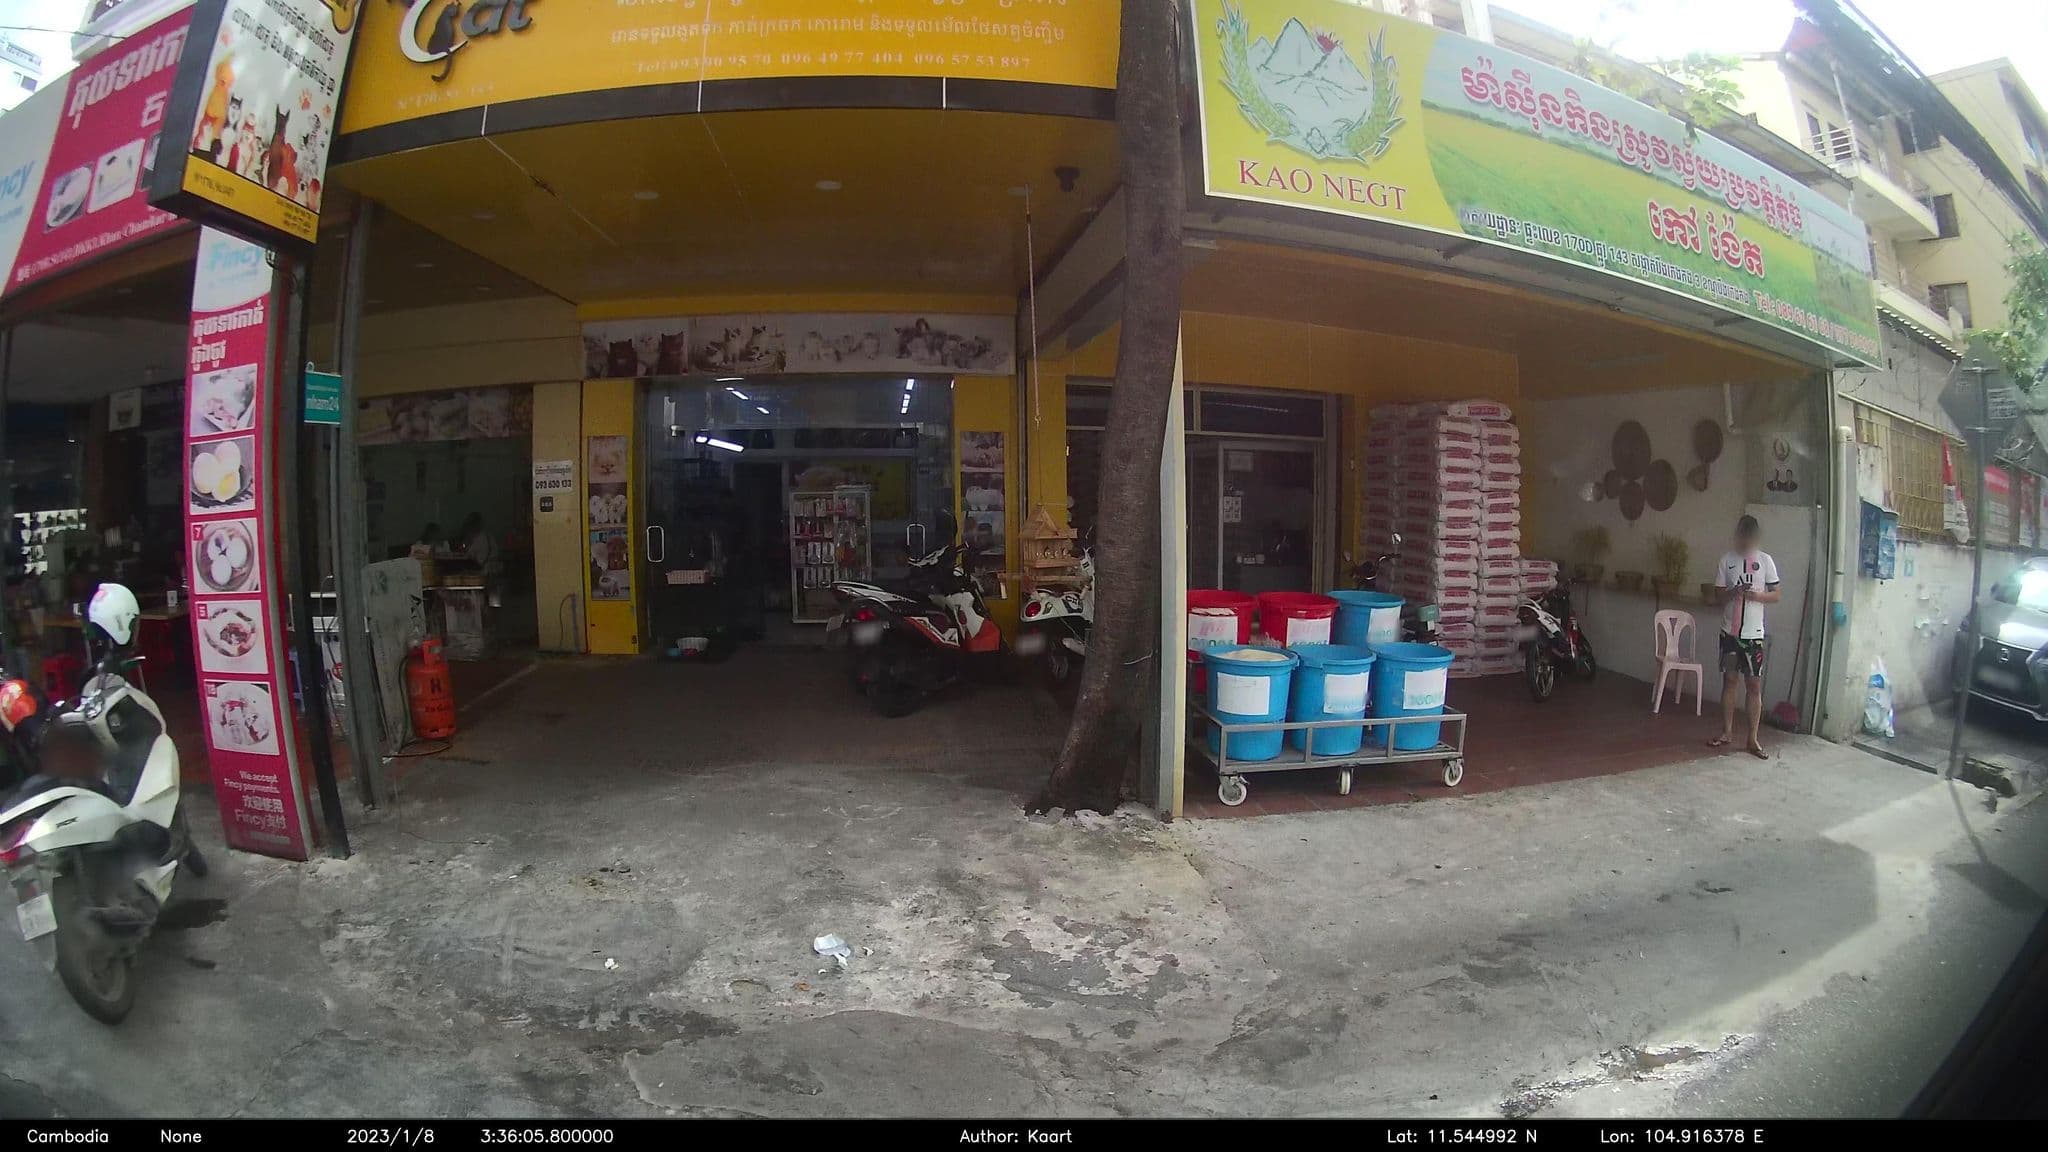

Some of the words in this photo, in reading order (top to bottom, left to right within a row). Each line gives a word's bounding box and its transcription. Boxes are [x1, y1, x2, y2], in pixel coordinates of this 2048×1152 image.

[1239, 159, 1313, 194] KAO
[1321, 173, 1406, 211] NEGT
[1564, 234, 1593, 254] 170D
[1609, 247, 1629, 265] 143
